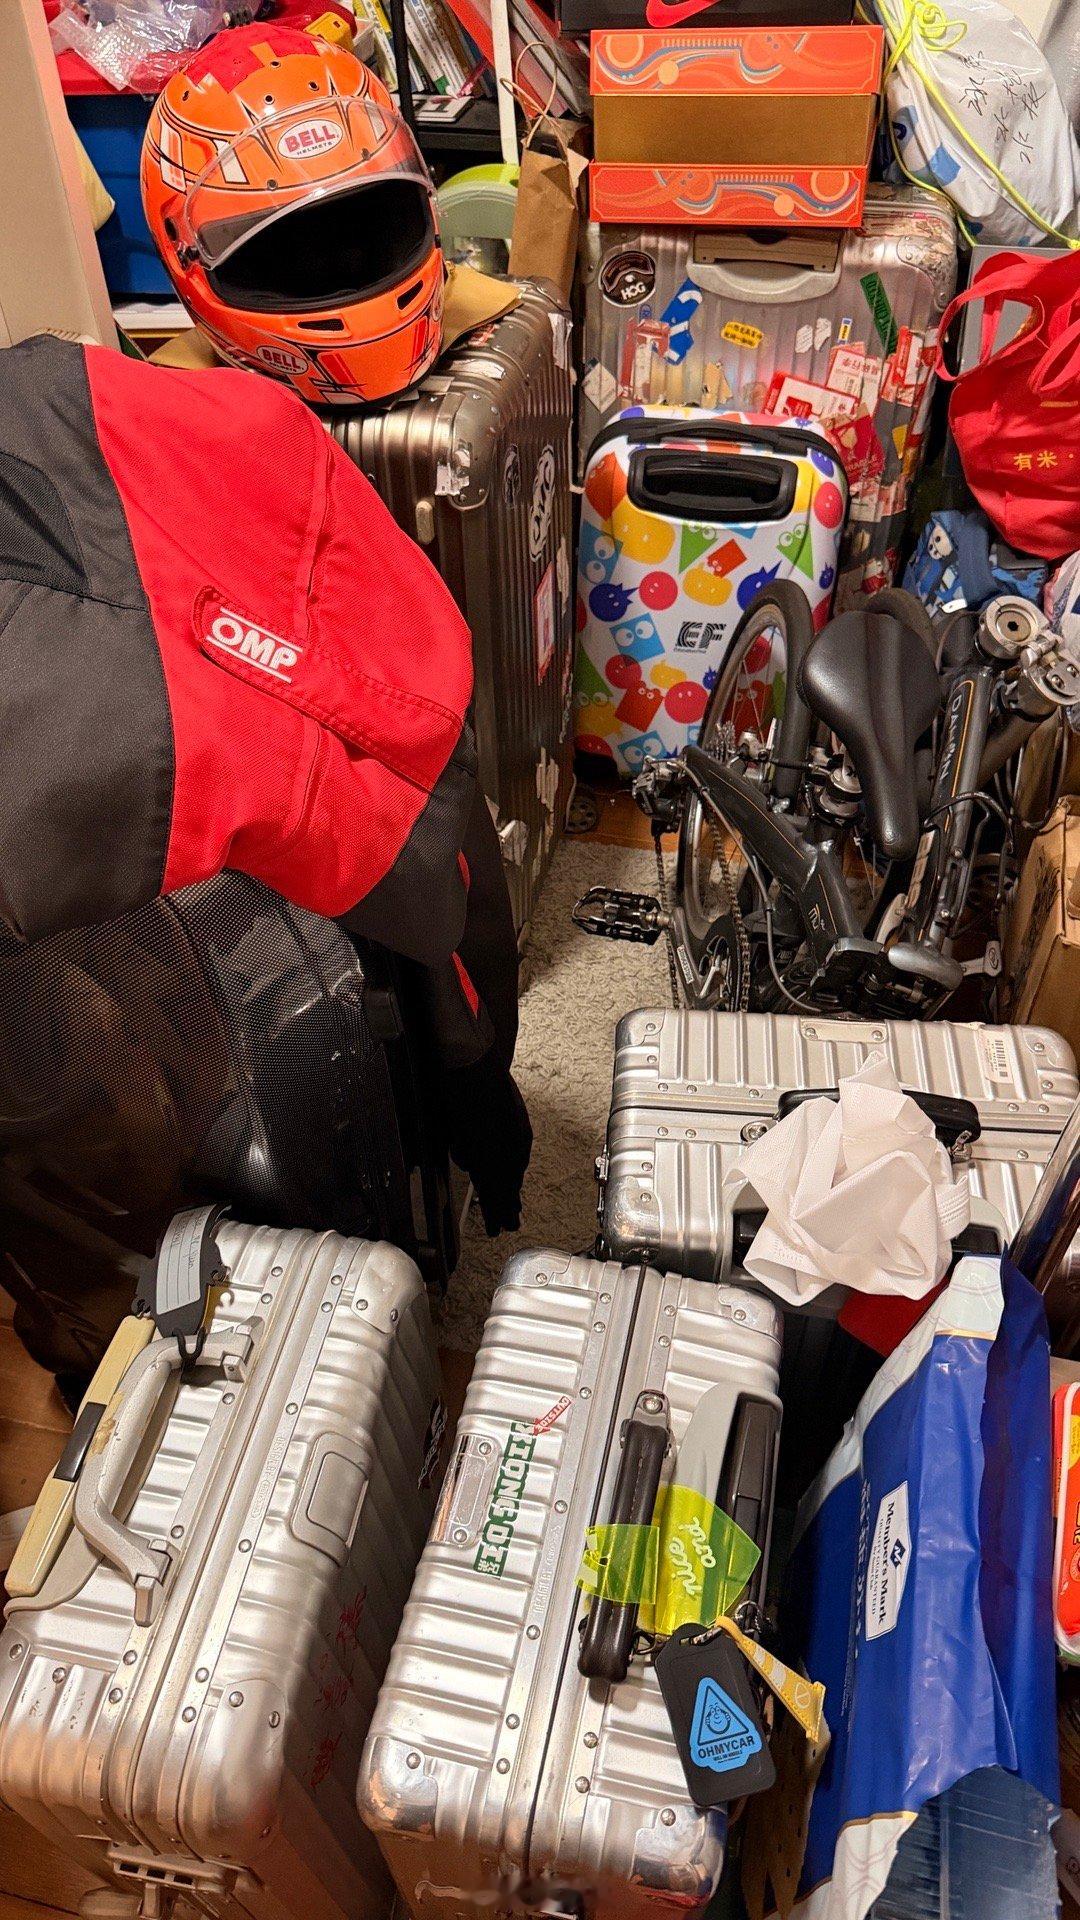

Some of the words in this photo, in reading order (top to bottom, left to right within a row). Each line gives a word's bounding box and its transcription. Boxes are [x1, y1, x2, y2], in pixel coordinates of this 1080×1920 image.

[285, 125, 335, 153] BELL
[297, 141, 333, 156] HELMETS
[621, 282, 646, 300] HOG
[262, 348, 301, 369] BELL
[1013, 450, 1058, 471] 有米
[212, 617, 298, 670] OMP
[675, 621, 727, 649] EF
[536, 1396, 572, 1433] OUTSIDE
[677, 1517, 716, 1568] and
[880, 1502, 897, 1576] Member's
[667, 1537, 703, 1595] nice
[875, 1578, 889, 1626] Mark
[697, 1734, 756, 1759] OHMYCAR
